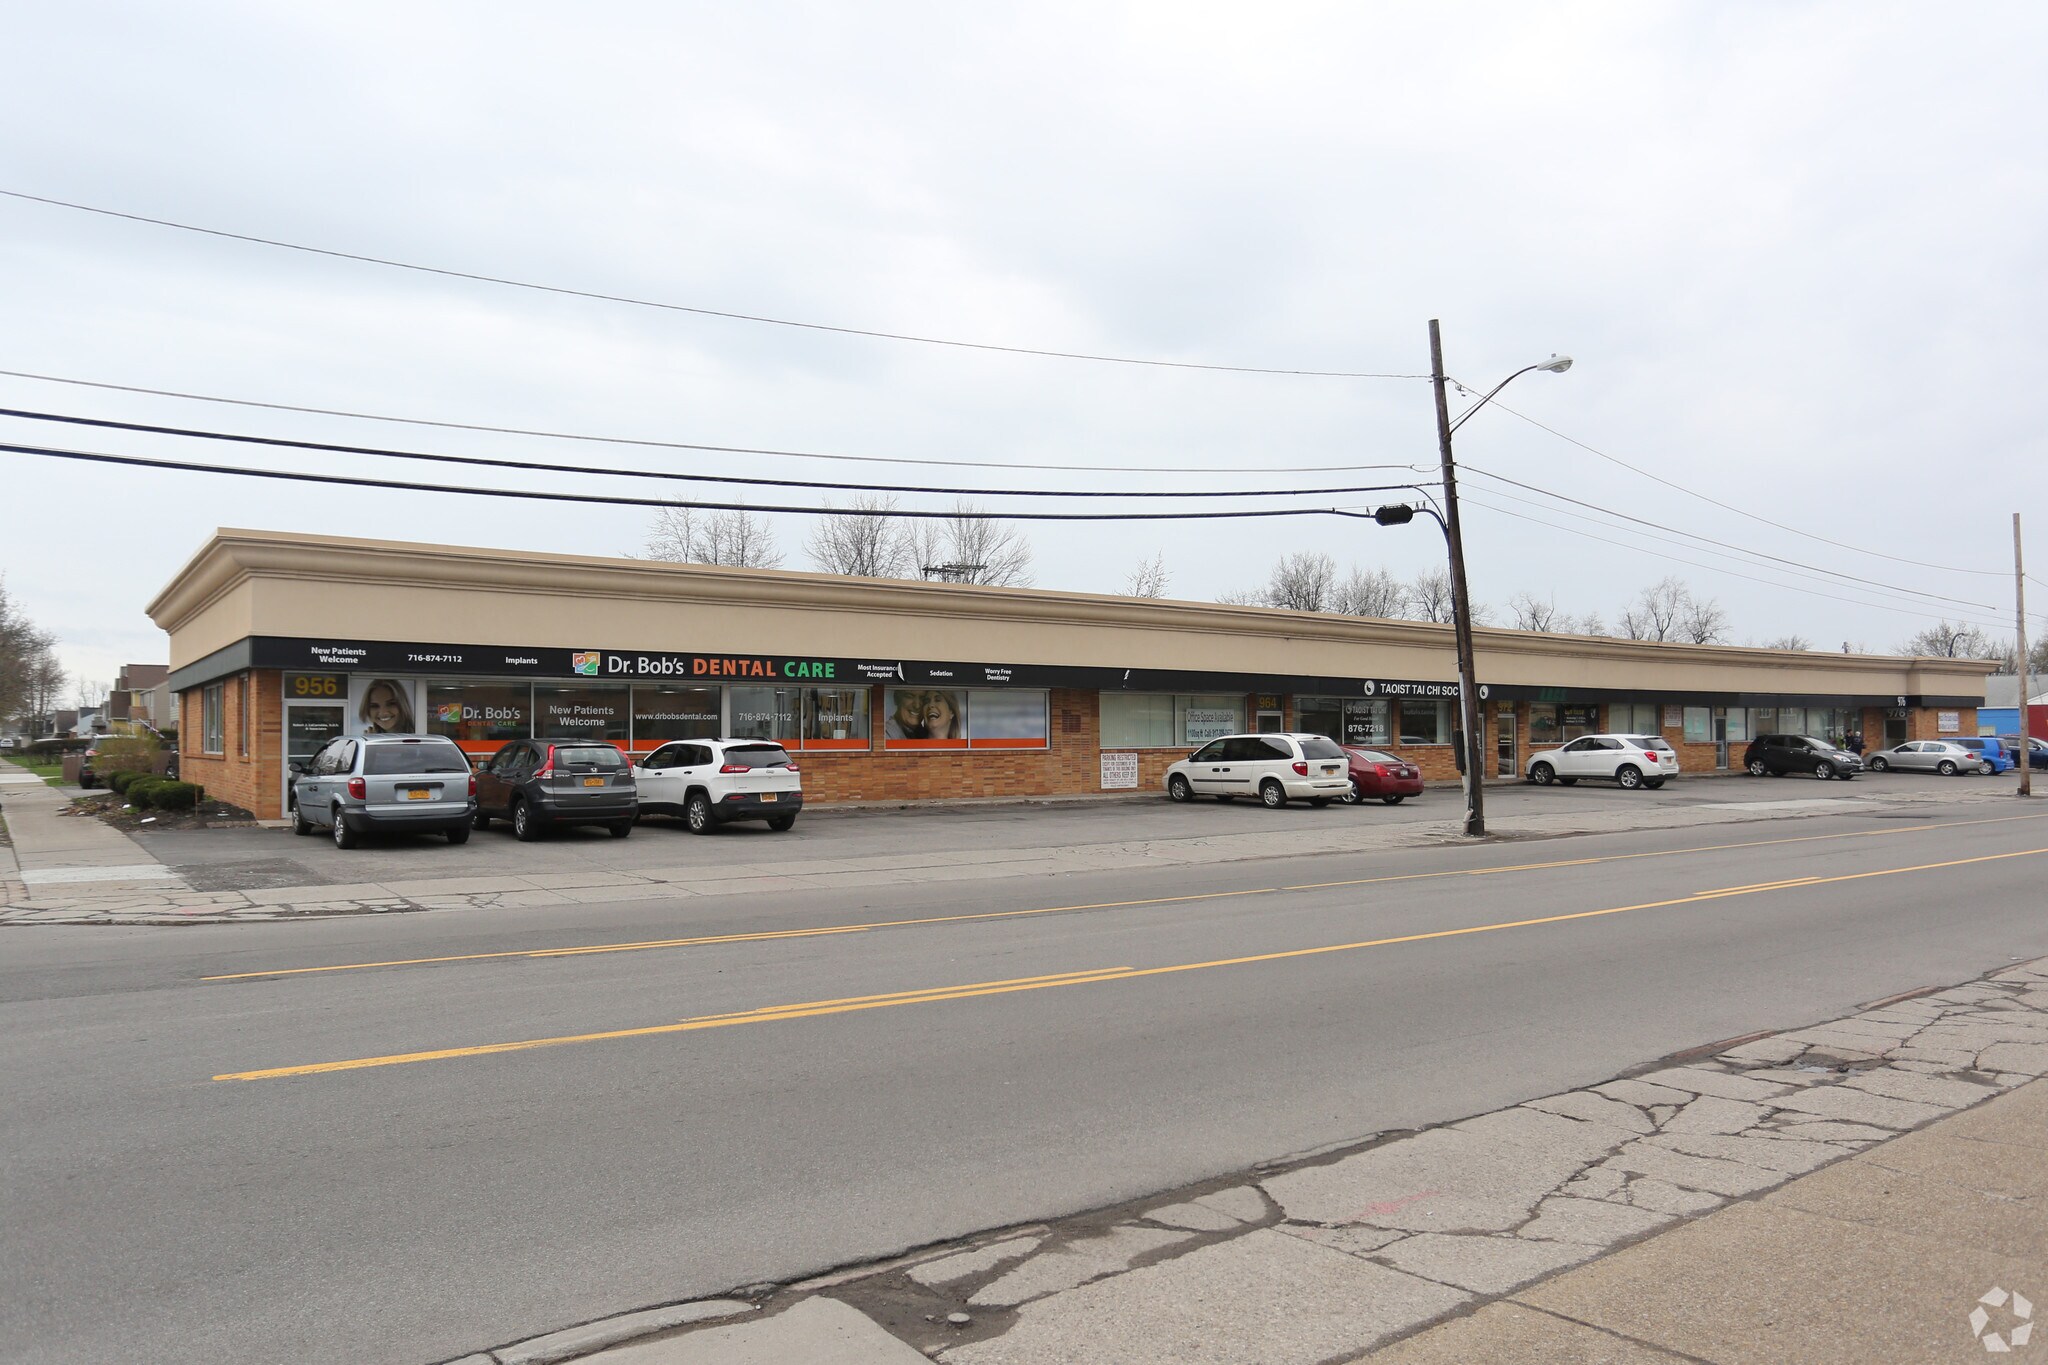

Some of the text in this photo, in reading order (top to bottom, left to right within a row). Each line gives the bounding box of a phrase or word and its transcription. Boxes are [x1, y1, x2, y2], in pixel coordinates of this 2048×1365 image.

[311, 647, 367, 656] New Patients
[319, 655, 359, 664] Welcome
[408, 654, 463, 663] 716-874-7112
[505, 657, 538, 665] Implants
[608, 655, 835, 679] Dr. Bob's DENTAL CARE
[866, 671, 893, 679] Accepted
[930, 669, 953, 677] Sedation
[985, 668, 1012, 677] Worry Free
[986, 674, 1010, 682] Dentistry
[295, 677, 337, 695] 956
[1380, 683, 1411, 694] TAOIST
[1412, 684, 1425, 695] TAI
[1426, 685, 1440, 695] CHI
[1259, 697, 1277, 708] 964
[1897, 696, 1906, 706] 976
[463, 706, 521, 720] Dr. Bob's
[549, 705, 615, 715] New Patients
[1352, 706, 1369, 714] TAOIST
[1887, 709, 1906, 718] 976
[635, 712, 718, 721] www.drbobsdental.com
[738, 712, 792, 721] 716-874-7112
[818, 713, 854, 723] Implants
[1187, 711, 1234, 725] Office Space Available
[559, 717, 605, 726] Welcome
[1348, 724, 1384, 733] 876-7218
